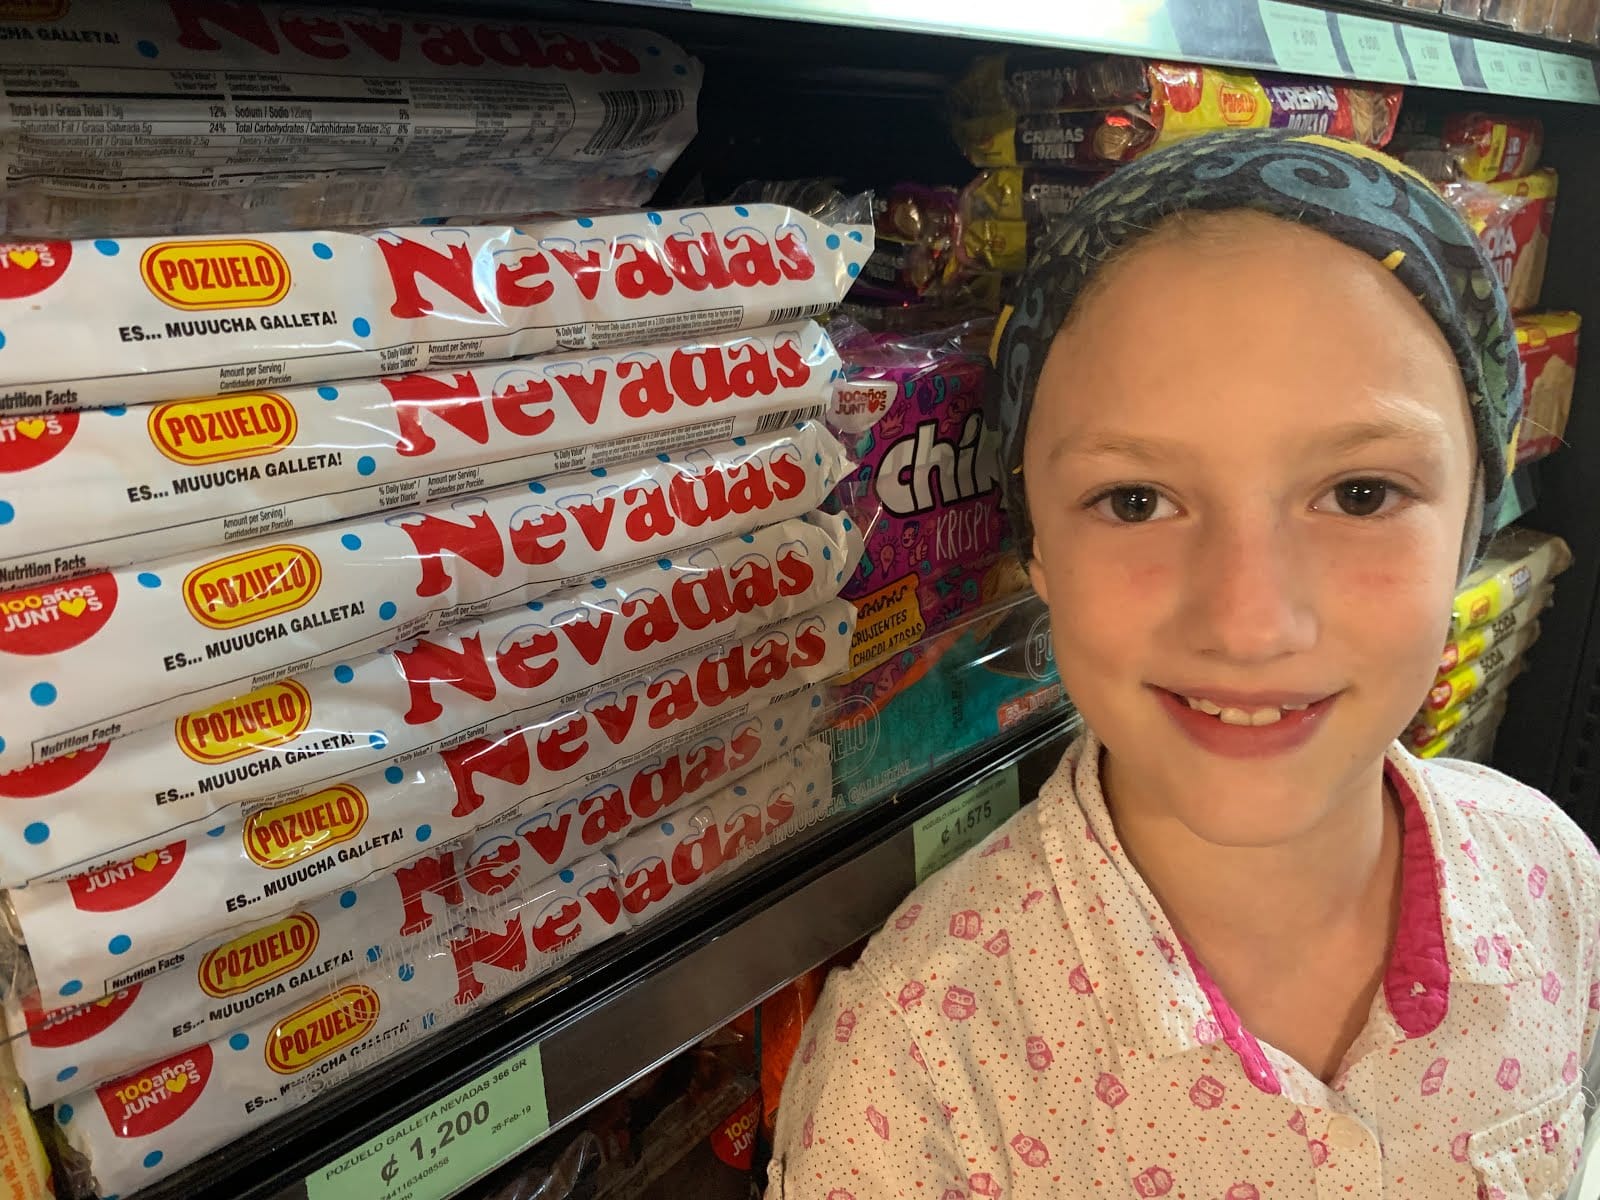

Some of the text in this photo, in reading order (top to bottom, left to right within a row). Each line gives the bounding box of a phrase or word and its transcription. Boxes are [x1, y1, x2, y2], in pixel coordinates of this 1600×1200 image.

[209, 122, 226, 133] 24%
[235, 122, 253, 133] Total
[1021, 127, 1085, 144] CREMAS
[158, 256, 275, 291] POZUELO
[375, 212, 815, 319] Nevadas
[118, 310, 338, 342] ES... MUUUCHA GALLETA!
[428, 341, 479, 353] Amount per Serving
[219, 362, 282, 379] Amount per Serving
[219, 374, 292, 390] Cantidades por Porción
[45, 387, 78, 405] Facts
[380, 330, 811, 457] Nevadas
[165, 404, 281, 447] POZUELO
[127, 452, 343, 503] ES... MUUUCHA GALLETA!
[386, 484, 400, 495] Daily
[428, 468, 477, 486] Amount per Serving
[456, 483, 465, 492] por
[223, 509, 283, 529] Amount per Serving
[386, 496, 400, 505] Valor
[224, 518, 294, 541] Cantidades por Porción
[400, 448, 806, 597] Nevadas
[936, 501, 992, 561] KRISPY
[0, 562, 51, 582] Nutrition
[54, 554, 86, 573] Facts
[199, 559, 306, 612] POZUELO
[163, 600, 365, 672] ES... MUUUCHA GALLETA!
[394, 543, 813, 725] Nevadas
[851, 609, 907, 648] CRUJIENTES
[853, 622, 922, 667] CHOCOLATOSAS
[252, 661, 309, 684] Amount per Serving
[191, 693, 297, 749] POZUELO
[440, 617, 825, 818] Nevadas
[40, 723, 121, 758] Nutrition Facts
[439, 728, 485, 749] Amount per Serving
[155, 731, 355, 806] ES... MUUUCHA GALLETA!
[253, 797, 355, 849] POZUELO
[397, 721, 762, 937] Nevadas
[225, 828, 404, 912] ES... MUUUCHA GALLETA!
[451, 793, 795, 1006] Nevadas
[214, 924, 305, 978] POZUELO
[112, 953, 185, 989] Nutrition Facts
[171, 949, 354, 1038] ES... MUUUCHA GALLETA!
[279, 998, 369, 1062] POZUELO
[244, 1095, 278, 1115] ES...
[326, 1058, 528, 1181] POZUELO GALLETA NEVADAS 366 GR
[491, 1105, 532, 1135] 26-Feb-19
[380, 1100, 490, 1187] ¢ 1,200
